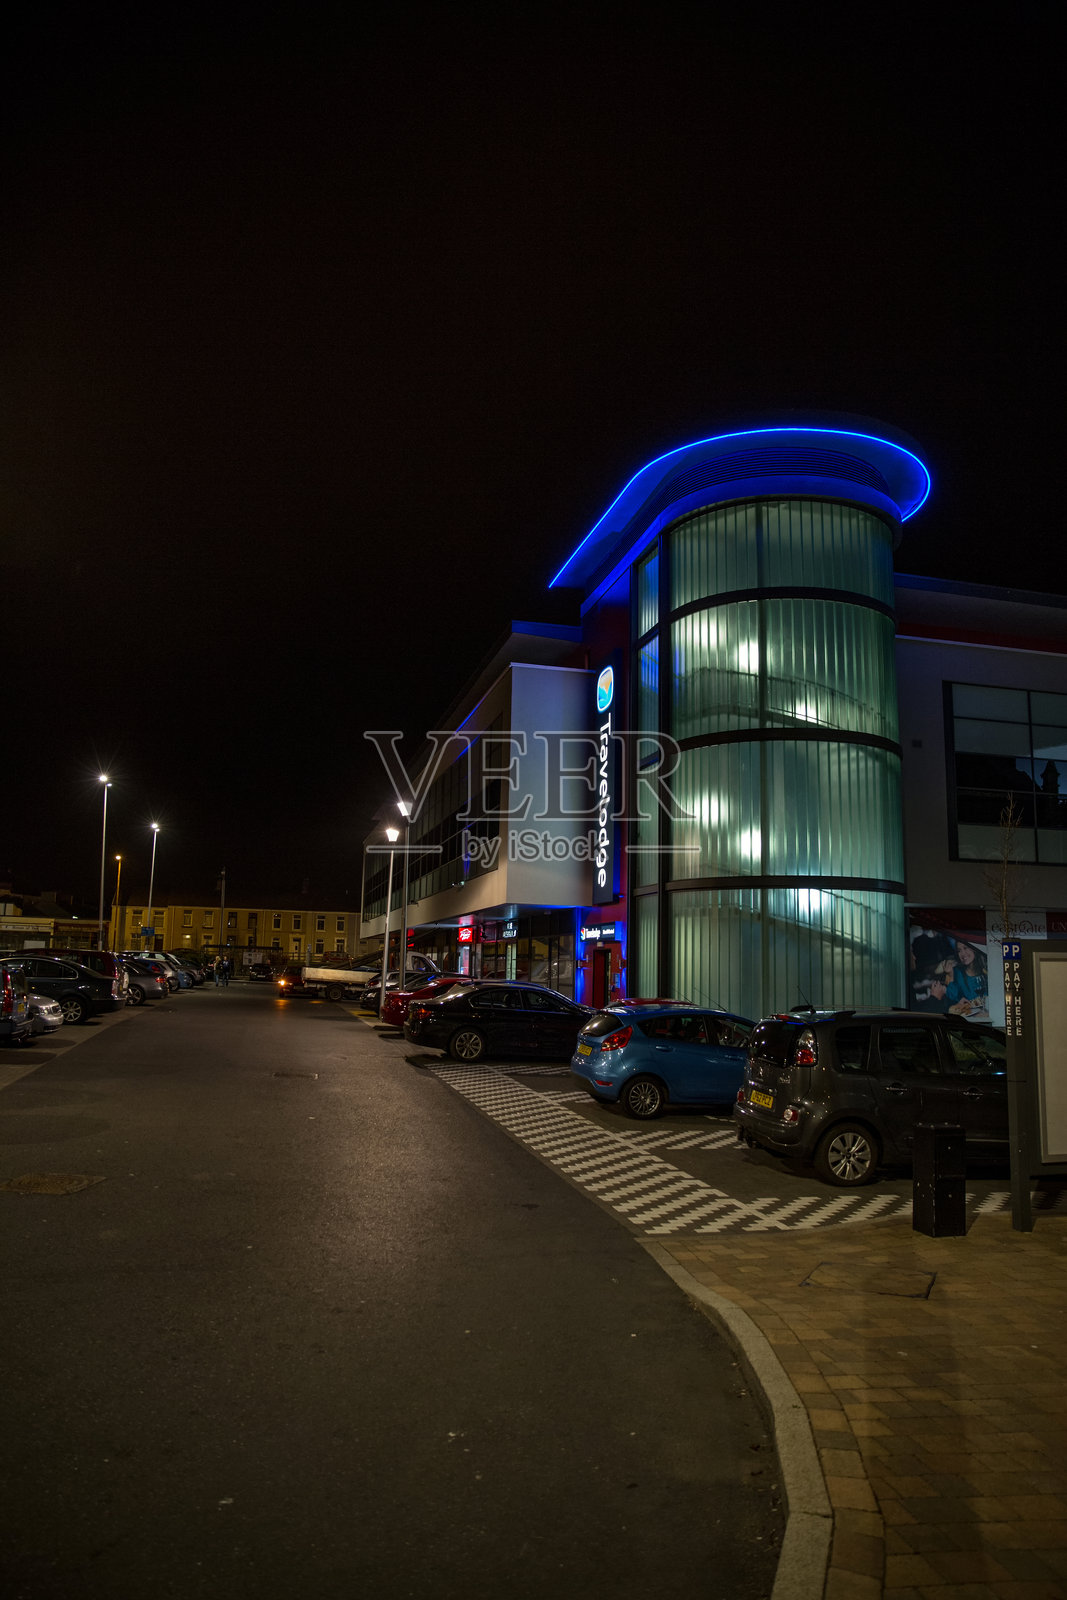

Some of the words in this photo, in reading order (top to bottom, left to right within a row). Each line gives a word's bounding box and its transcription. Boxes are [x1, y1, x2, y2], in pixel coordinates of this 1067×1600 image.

[595, 713, 613, 888] Travelodge
[1003, 945, 1010, 957] P
[1012, 945, 1021, 957] P
[1013, 962, 1021, 992] PAY
[1005, 995, 1013, 1036] HERE
[1014, 996, 1023, 1036] HERE
